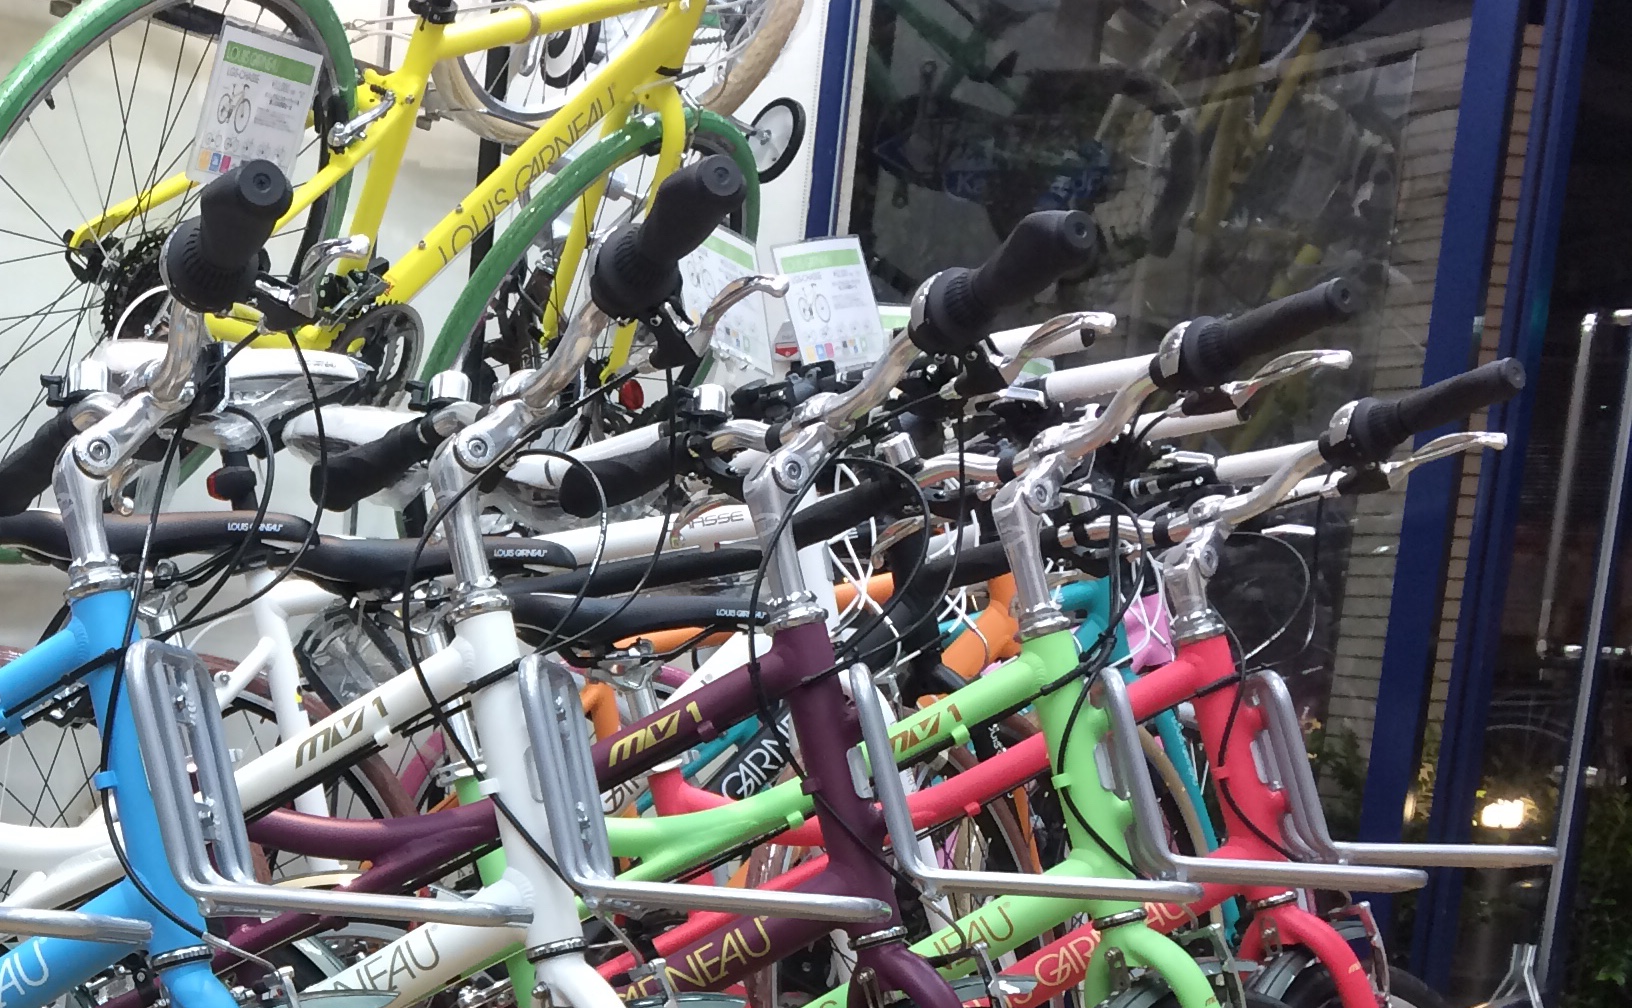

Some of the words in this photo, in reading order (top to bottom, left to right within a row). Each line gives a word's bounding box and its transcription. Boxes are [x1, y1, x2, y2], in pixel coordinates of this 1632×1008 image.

[438, 188, 510, 265] LOUIS
[514, 86, 615, 193] GARNEAU
[228, 522, 248, 531] LOUIS
[494, 548, 515, 558] LOUIS
[716, 608, 737, 617] LOUIS
